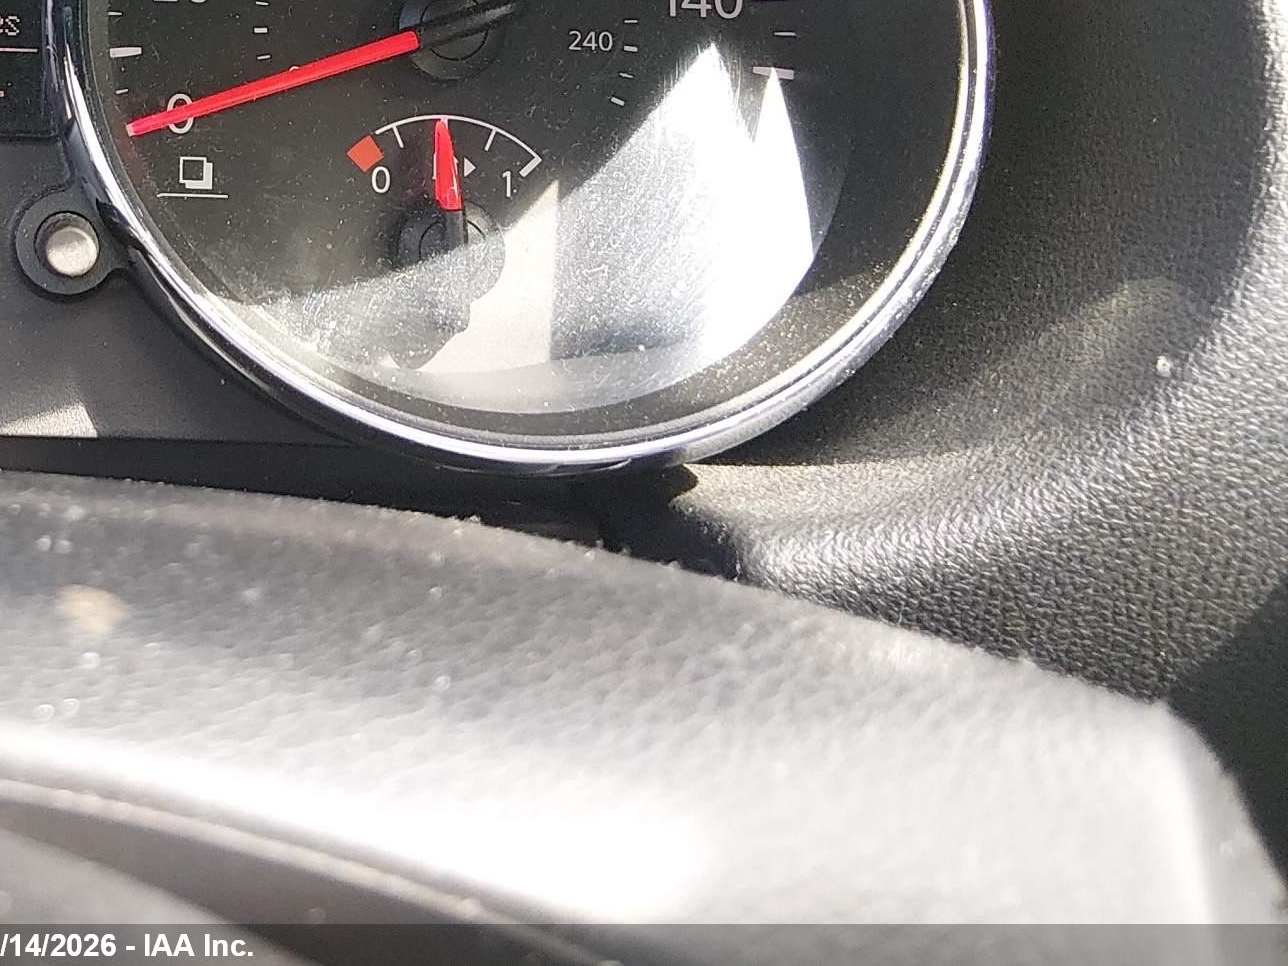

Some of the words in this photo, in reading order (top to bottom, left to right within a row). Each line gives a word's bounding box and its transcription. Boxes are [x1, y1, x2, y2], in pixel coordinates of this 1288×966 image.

[568, 30, 614, 52] 240
[166, 93, 195, 134] 0
[370, 166, 392, 194] 0
[500, 171, 514, 198] 1
